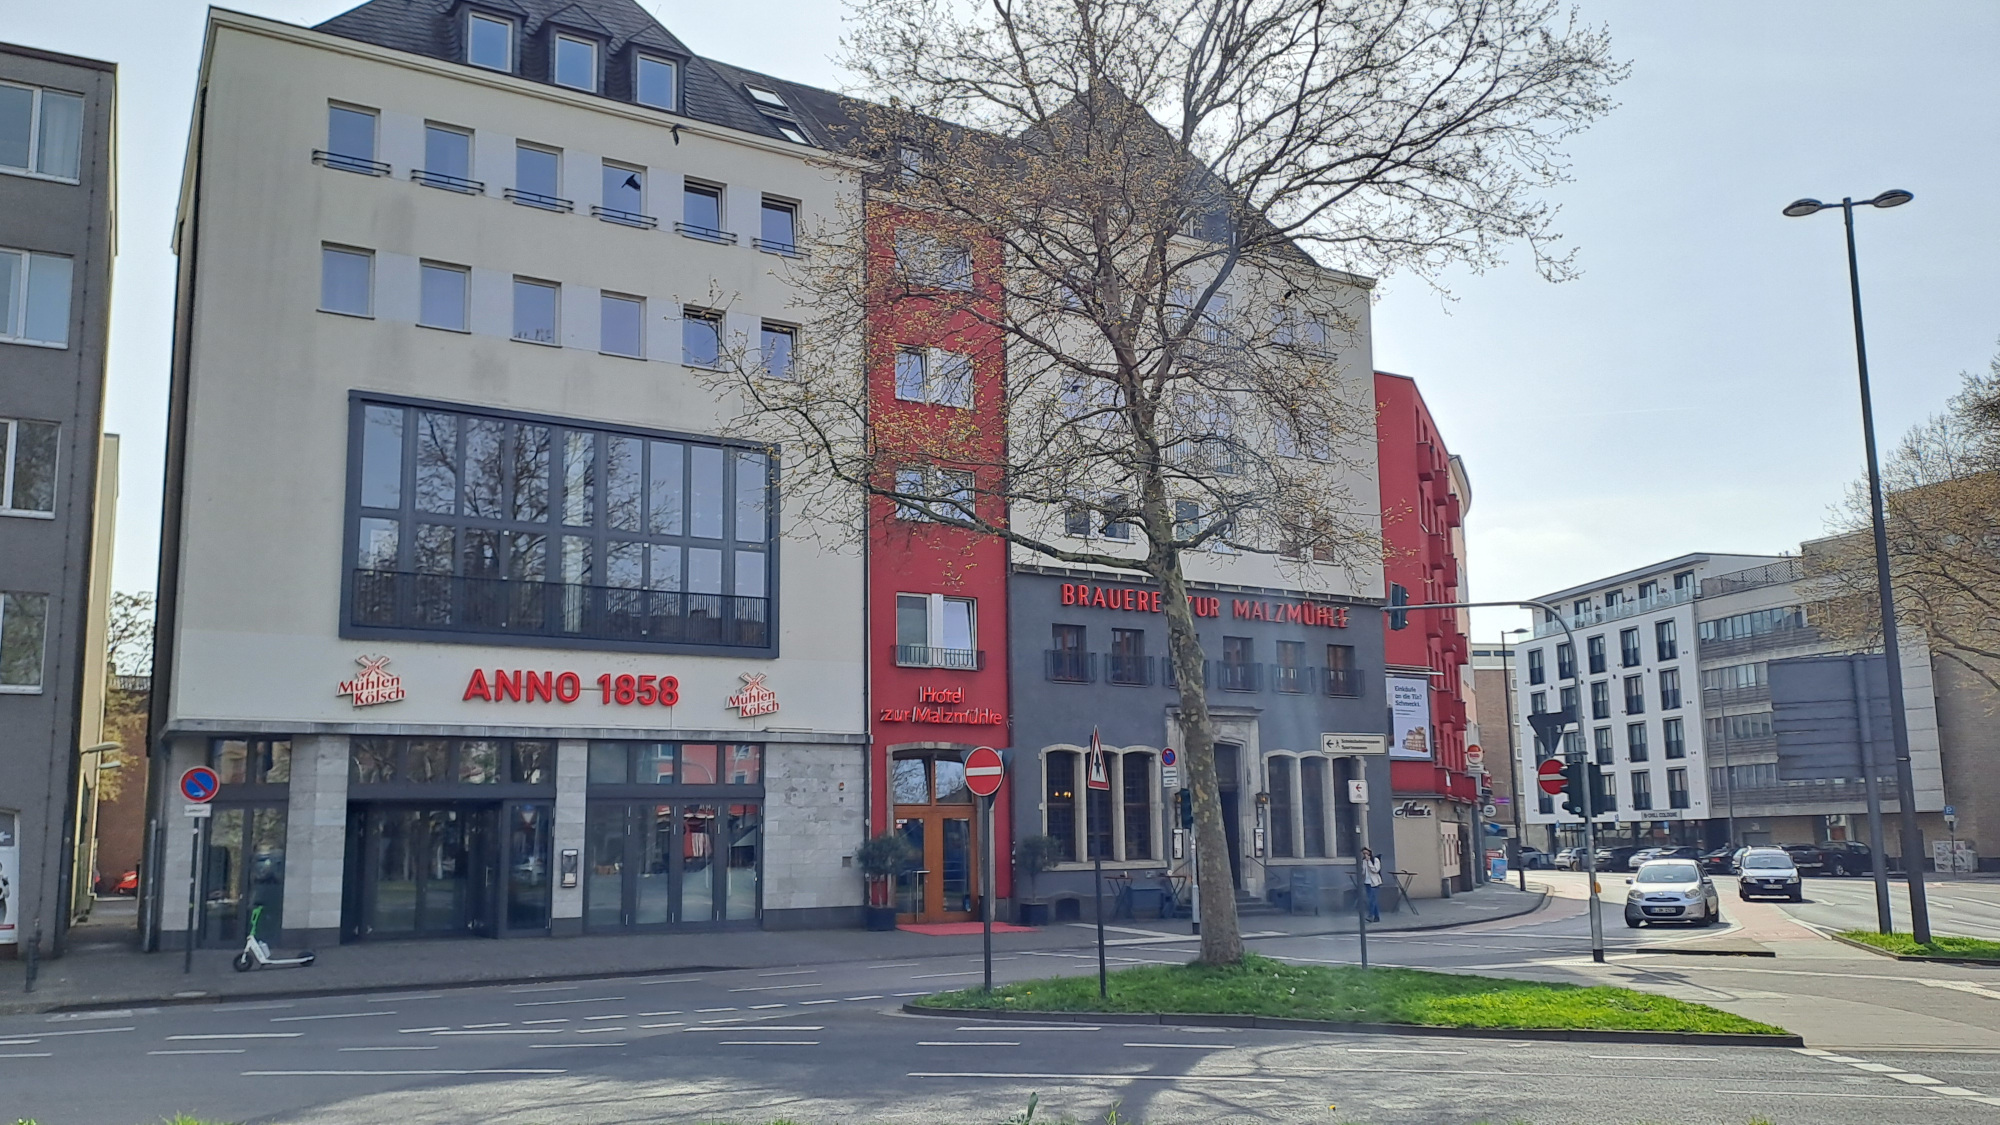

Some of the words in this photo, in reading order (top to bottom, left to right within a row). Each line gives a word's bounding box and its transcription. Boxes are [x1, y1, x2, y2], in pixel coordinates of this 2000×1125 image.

[1061, 583, 1162, 613] BRAUERE
[1233, 599, 1350, 628] MALZMÜHLE
[338, 676, 400, 695] Mühlen
[462, 668, 580, 704] ANNO
[597, 673, 679, 706] 1858
[919, 686, 965, 703] Hotel
[354, 686, 405, 705] Kölsch
[728, 691, 775, 708] Mühlen
[741, 700, 779, 716] Kölsch
[880, 708, 911, 722] zur
[912, 706, 1003, 725] Malzmühle
